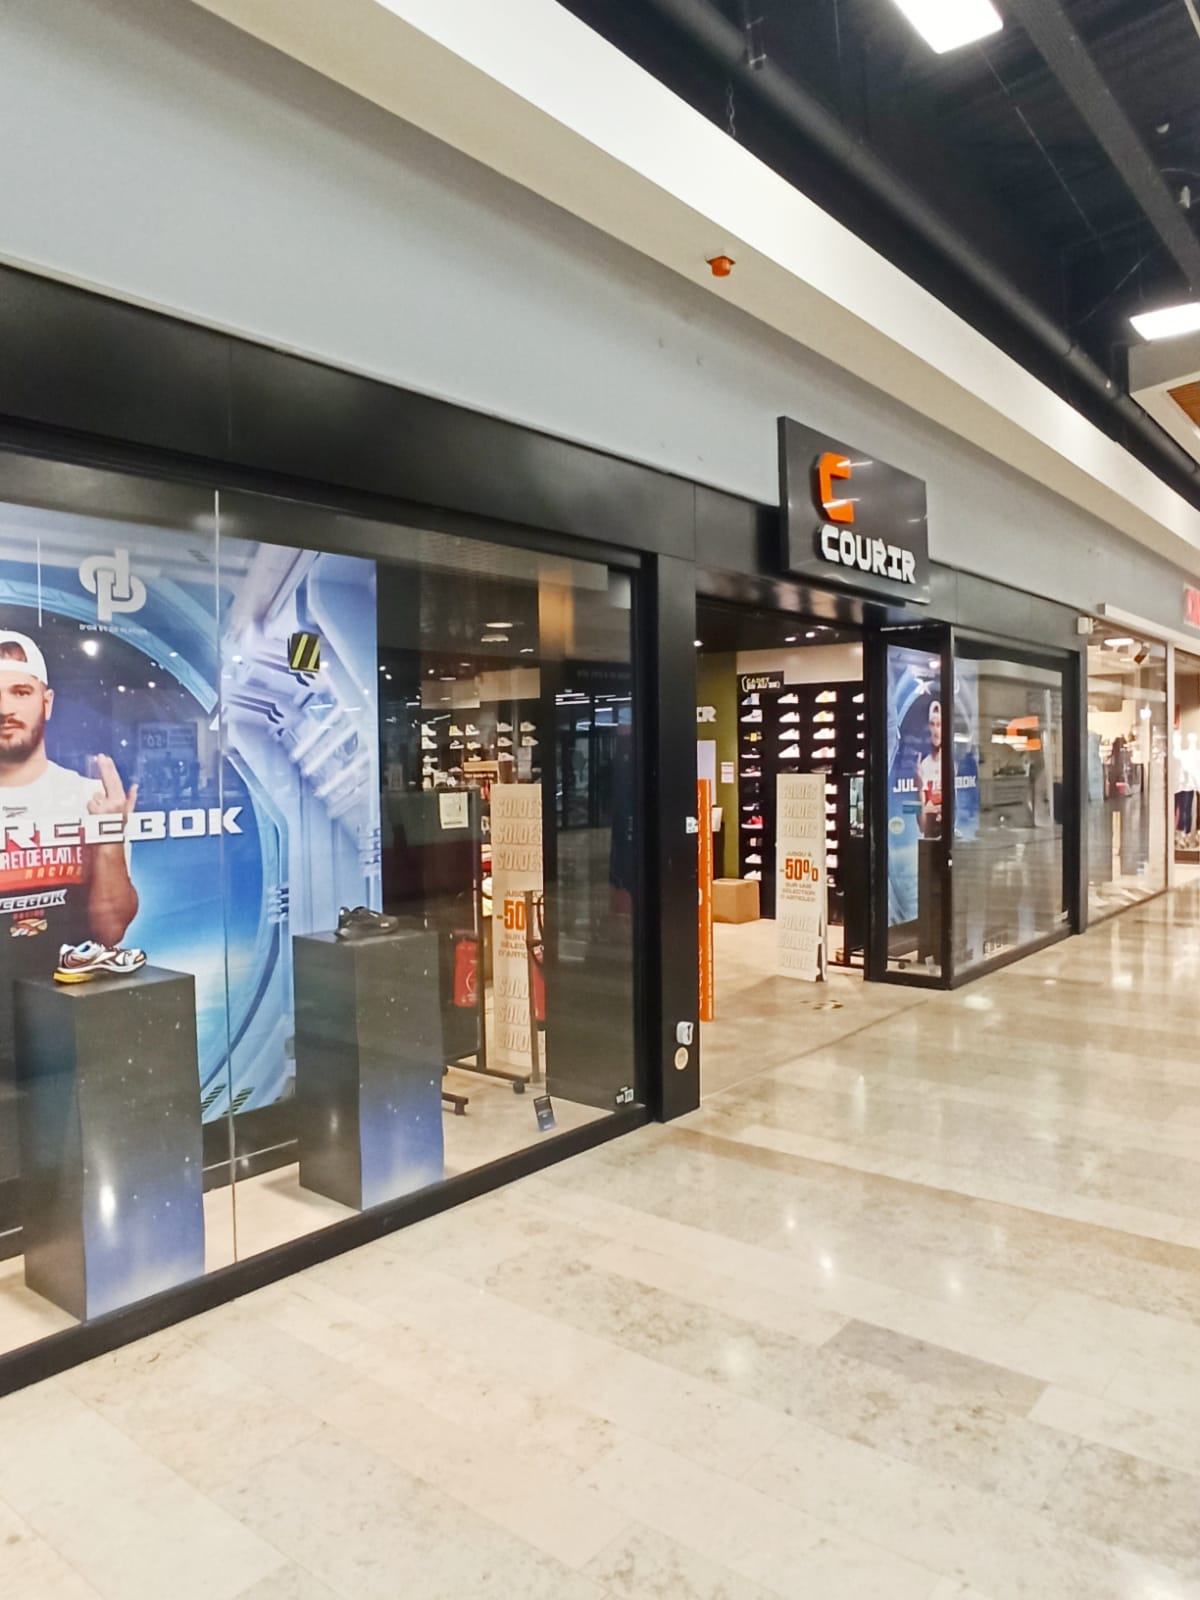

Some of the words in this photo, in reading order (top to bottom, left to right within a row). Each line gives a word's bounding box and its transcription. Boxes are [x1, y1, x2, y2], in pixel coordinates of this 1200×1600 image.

[821, 523, 916, 584] COURIR
[893, 778, 918, 793] JUL
[780, 858, 819, 882] -50%
[496, 899, 527, 931] -50
